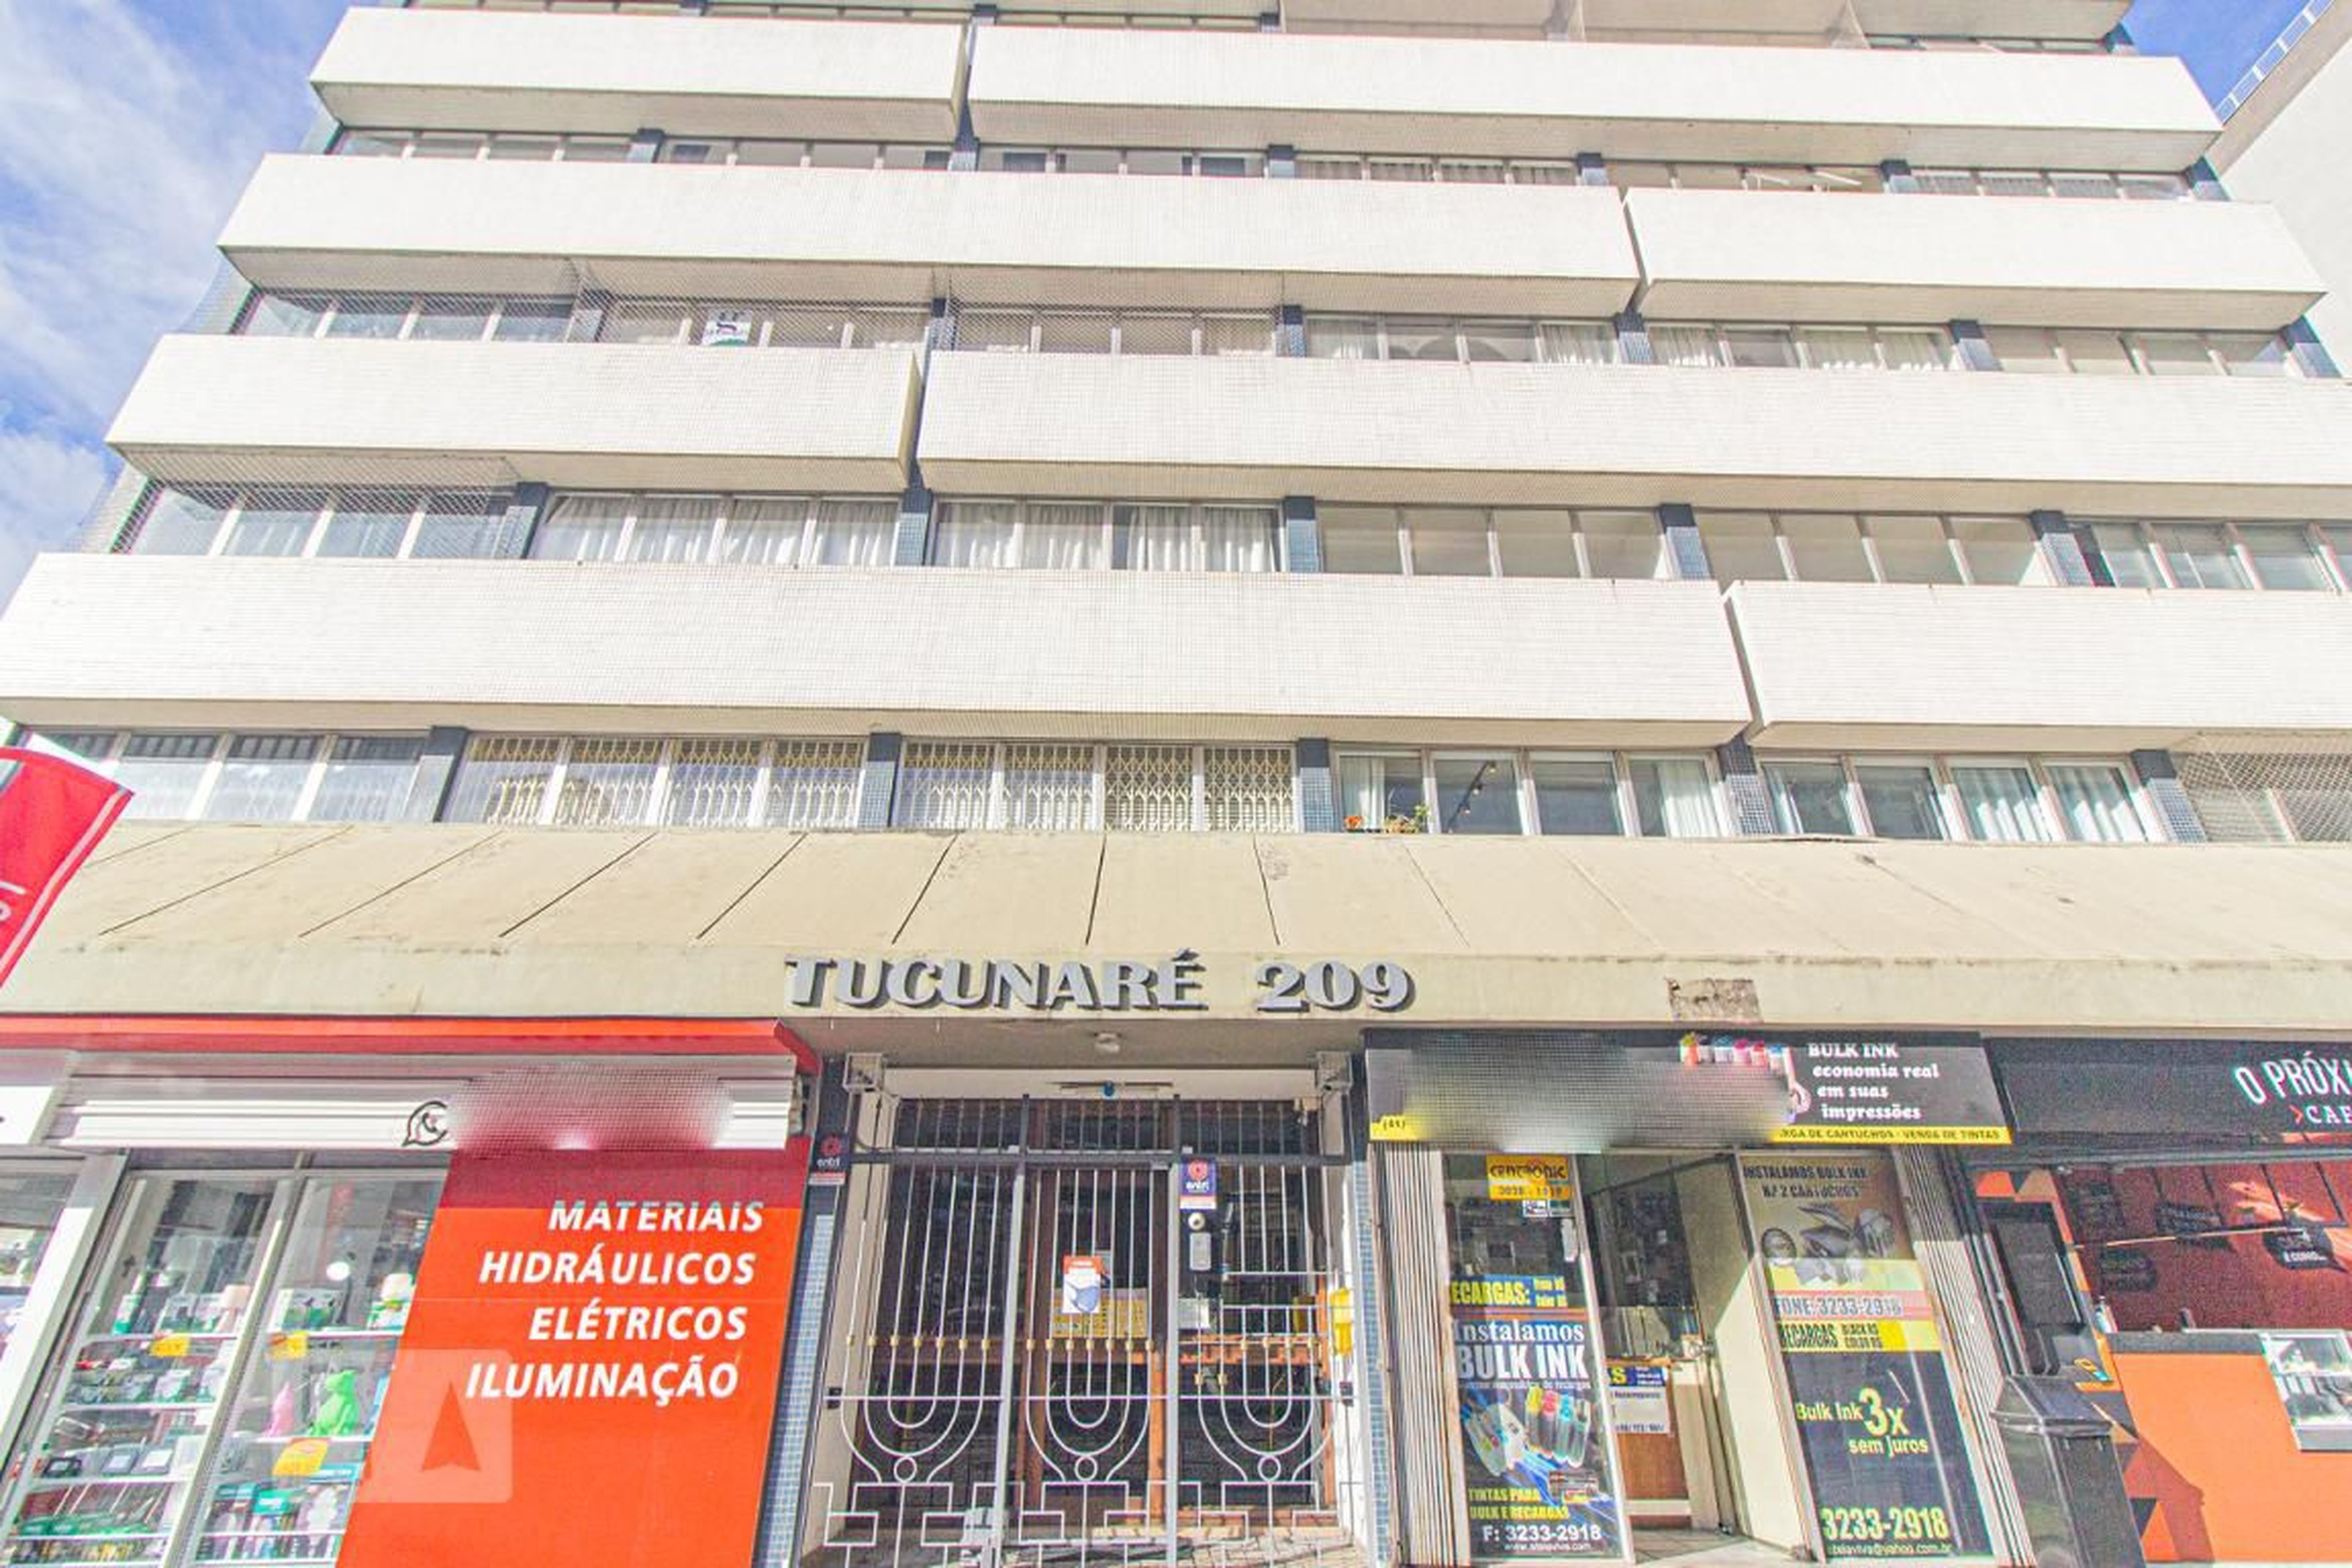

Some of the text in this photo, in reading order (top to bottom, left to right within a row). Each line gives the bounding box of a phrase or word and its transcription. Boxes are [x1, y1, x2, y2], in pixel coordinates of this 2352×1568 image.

[784, 948, 1415, 1012] TUCUNARÉ 209
[1807, 1042, 1899, 1058] BULK INK
[1812, 1063, 1940, 1079] economia real
[1817, 1085, 1889, 1098] em suas
[2233, 1066, 2267, 1105] O
[1821, 1104, 1922, 1122] impressões
[1808, 1128, 1823, 1139] DE
[1827, 1128, 1894, 1139] CARTUCHOS
[1961, 1129, 2000, 1140] TINTAS
[549, 1199, 764, 1231] MATERIAIS
[479, 1243, 756, 1284] HIDRÁULICOS
[1450, 1281, 1530, 1305] ECARGAS:
[529, 1298, 747, 1340] ELÉTRICOS
[1453, 1319, 1585, 1341] Instalamos
[1457, 1344, 1589, 1380] BULK INK
[465, 1355, 739, 1406] ILUMINAÇÃO
[1796, 1403, 1833, 1421] Bulk
[1837, 1403, 1864, 1420] Ink
[1849, 1435, 1929, 1458] sem juros
[1482, 1524, 1602, 1542] F: 3233-2918
[1820, 1507, 1949, 1540] 3233-2918
